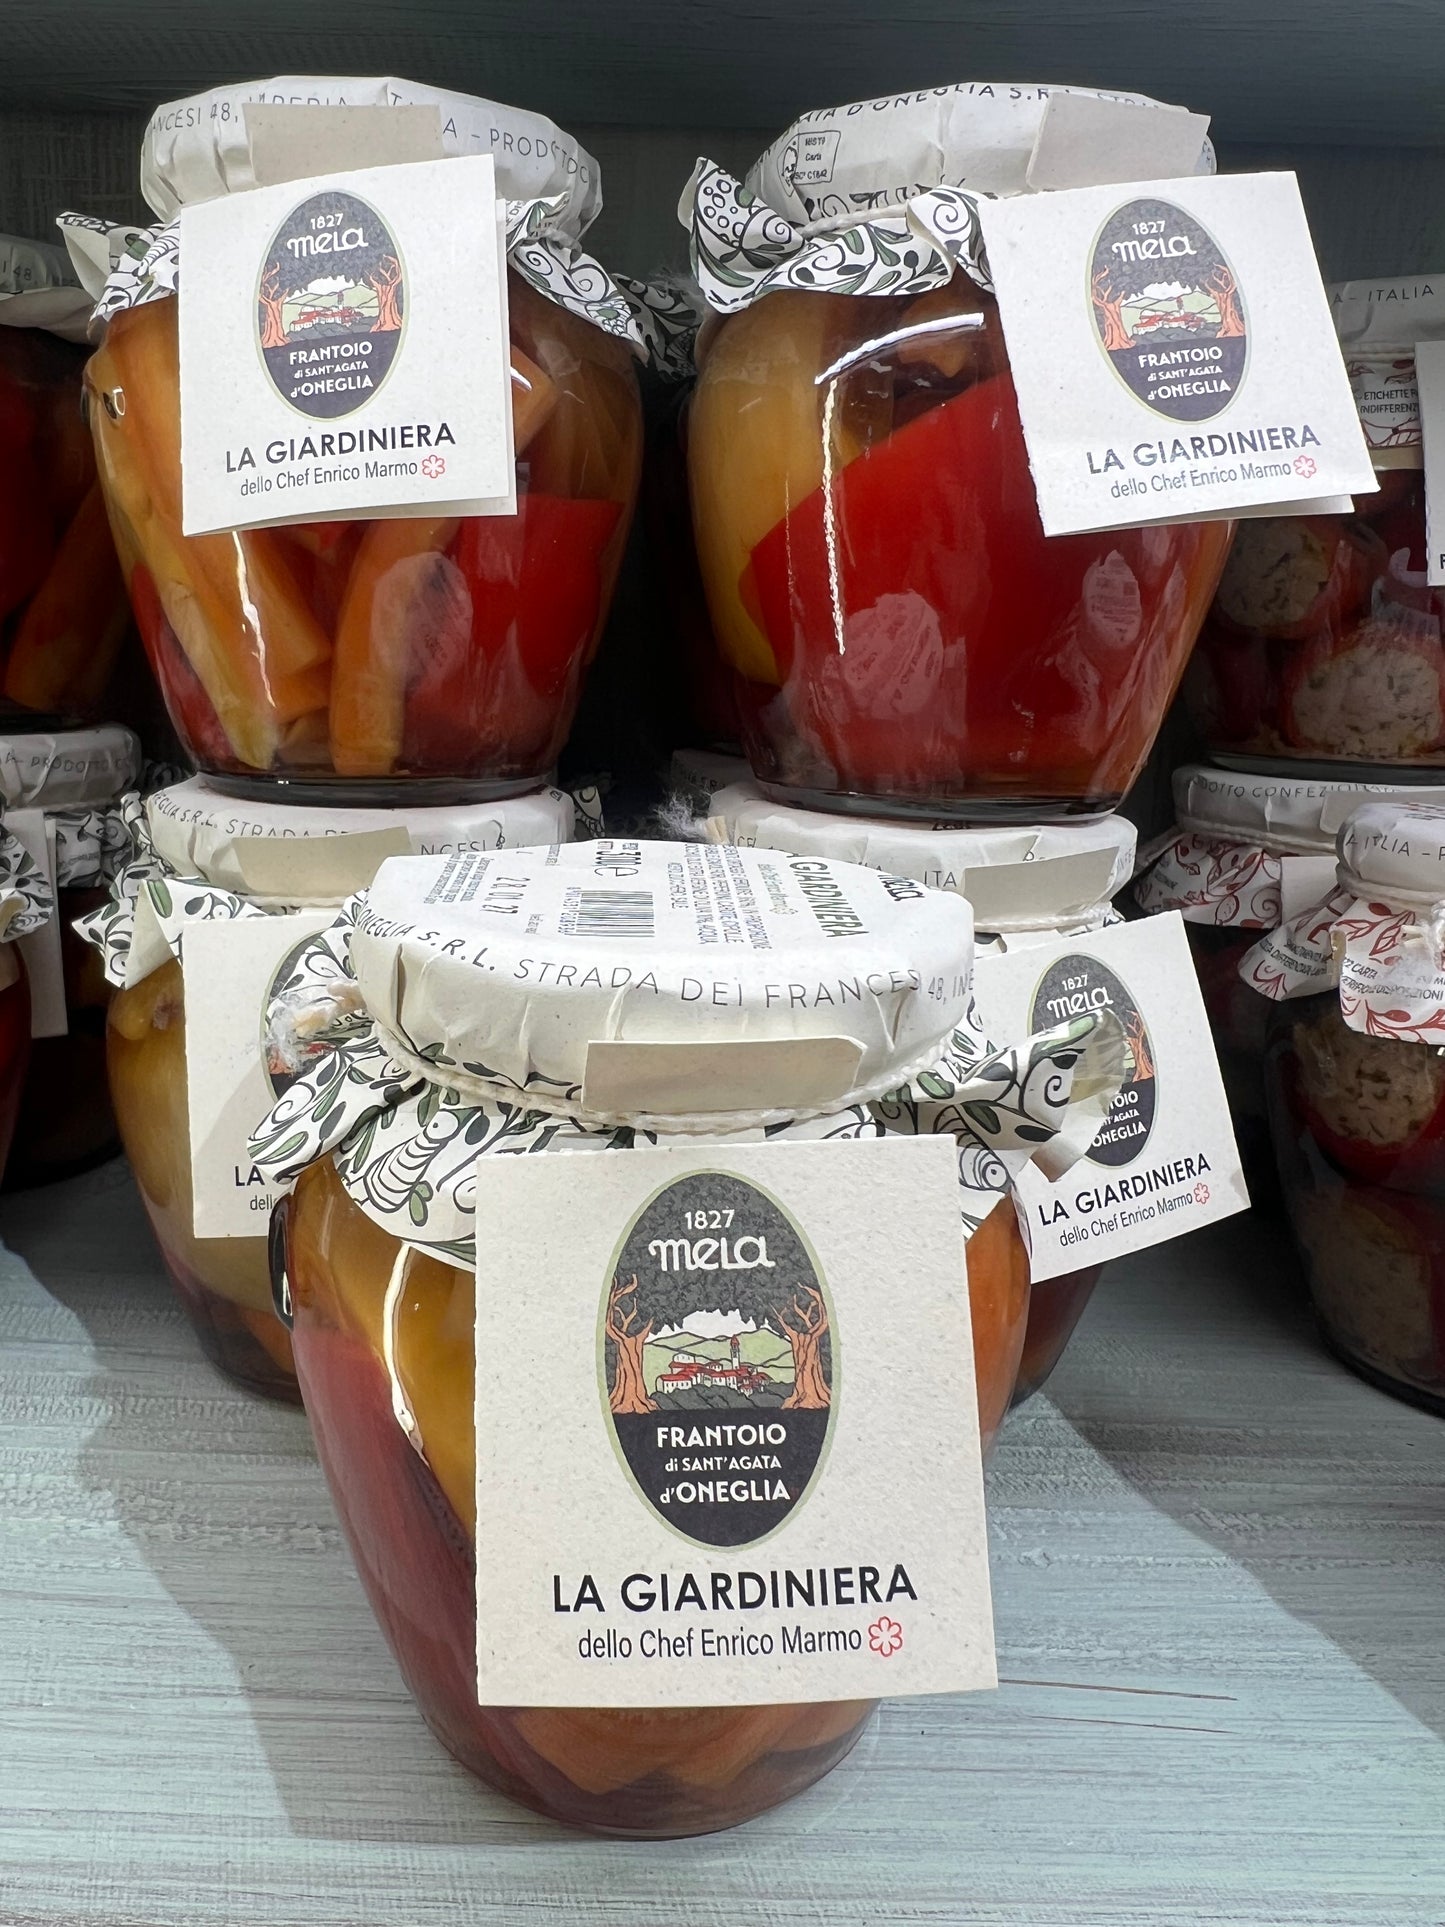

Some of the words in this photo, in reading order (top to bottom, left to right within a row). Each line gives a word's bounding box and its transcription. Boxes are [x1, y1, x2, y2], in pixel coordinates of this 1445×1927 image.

[310, 213, 344, 230] 1827
[1131, 220, 1166, 235] 1827
[286, 227, 369, 258] mela
[1111, 236, 1197, 262] mela
[1368, 284, 1434, 302] ITALIA
[289, 341, 373, 365] FRANTOIO
[1138, 346, 1223, 368] FRANTOIO
[294, 369, 303, 379] di
[305, 360, 369, 378] SANT'AGATA
[1147, 370, 1157, 382] di
[1159, 365, 1223, 380] SANT'AGATA
[290, 374, 374, 398] d'ONEGLIA
[1147, 379, 1231, 401] d'ONEGLIA
[225, 446, 256, 473] LA
[265, 422, 456, 464] GIARDINIERA
[1086, 448, 1126, 474] LA
[1133, 424, 1322, 467] GIARDINIERA
[240, 476, 272, 496] dello
[276, 469, 309, 490] Chef
[314, 464, 360, 484] Enrico
[365, 460, 418, 479] Marmo
[1110, 480, 1148, 498] dello
[1151, 470, 1187, 492] Chef
[1189, 466, 1238, 487] Enrico
[1239, 461, 1292, 480] Marmo
[789, 861, 870, 938] GIARDINIERA
[417, 930, 495, 972] S.R.L.
[513, 958, 660, 995] STRADA
[680, 977, 743, 1007] DEI
[1061, 973, 1089, 991] 1827
[1046, 985, 1114, 1019] mela
[1091, 1121, 1148, 1147] ONEGLIA
[234, 1164, 265, 1187] LA
[1038, 1199, 1070, 1226] LA
[1074, 1152, 1212, 1214] GIARDINIERA
[684, 1209, 735, 1230] 1827
[1059, 1221, 1089, 1247] dello
[1091, 1211, 1119, 1238] Chef
[1121, 1205, 1156, 1228] Enrico
[1157, 1191, 1193, 1216] Marmo
[648, 1235, 776, 1272] mela
[657, 1423, 787, 1448] FRANTOIO
[665, 1457, 679, 1473] di
[682, 1454, 782, 1472] SANT'AGATA
[660, 1478, 791, 1504] d'ONEGLIA
[553, 1574, 605, 1613] LA
[620, 1563, 918, 1612] GIARDINIERA
[578, 1628, 633, 1659] dello
[639, 1626, 694, 1658] Chef
[702, 1625, 774, 1656] Enrico
[781, 1624, 863, 1654] Marmo
